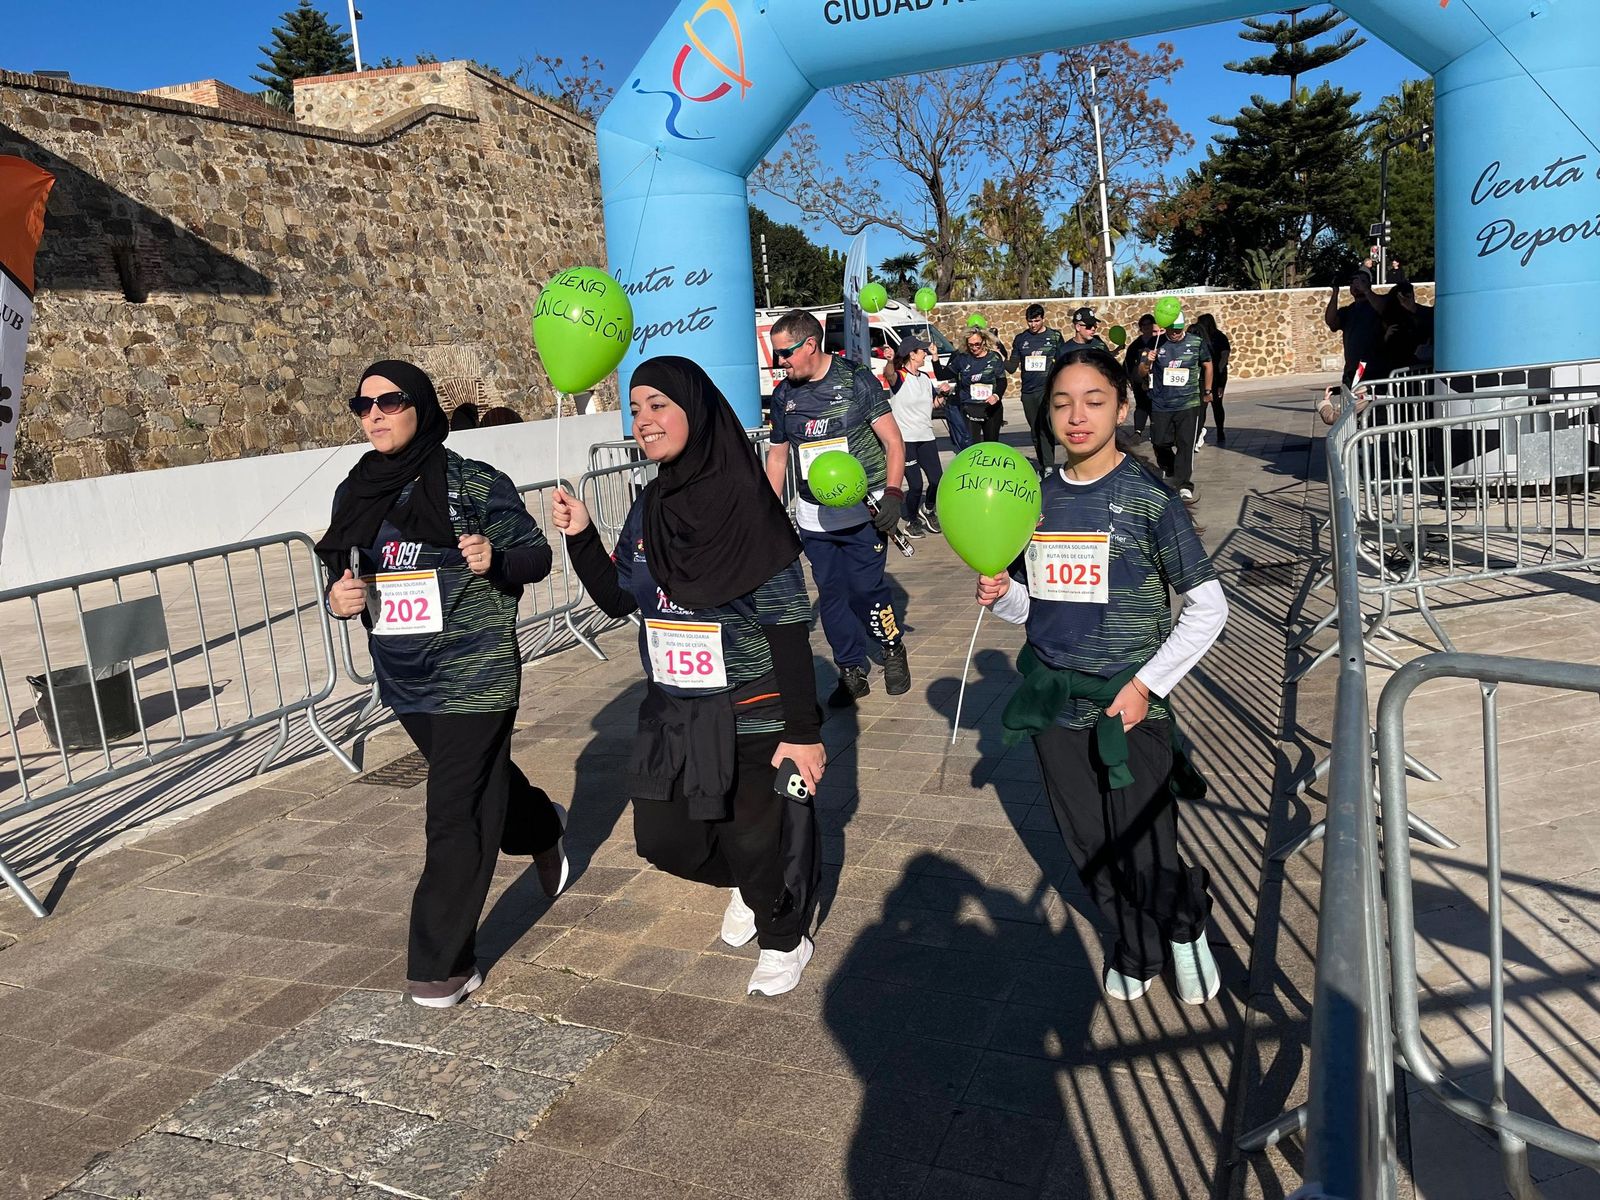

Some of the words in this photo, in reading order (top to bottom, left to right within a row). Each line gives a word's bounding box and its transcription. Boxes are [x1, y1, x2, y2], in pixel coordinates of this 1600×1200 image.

[685, 268, 713, 286] es
[1, 303, 24, 330] UB
[633, 306, 717, 355] eporte
[1170, 375, 1185, 383] 396
[969, 449, 1015, 470] PLENA
[956, 472, 1037, 504] INCLUSIÓN
[1045, 563, 1101, 586] 1025
[384, 597, 431, 622] 202
[666, 650, 714, 675] 158
